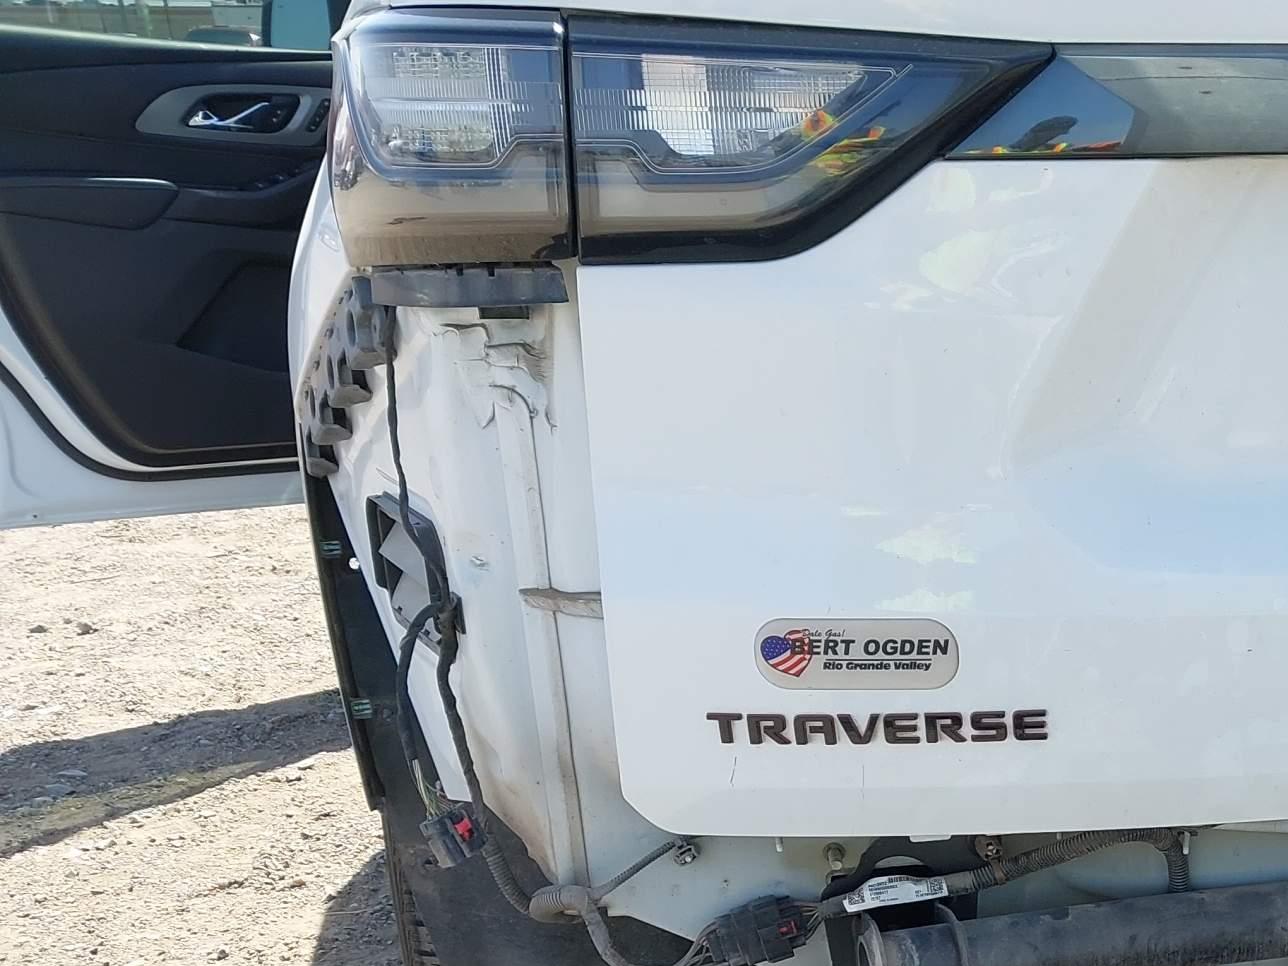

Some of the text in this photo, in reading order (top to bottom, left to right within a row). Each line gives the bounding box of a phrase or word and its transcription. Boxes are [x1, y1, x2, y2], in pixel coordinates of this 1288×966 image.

[791, 638, 950, 656] BERT OGDEN
[823, 660, 932, 672] Rio Grande Valley
[706, 709, 1049, 745] TRAVERSE
